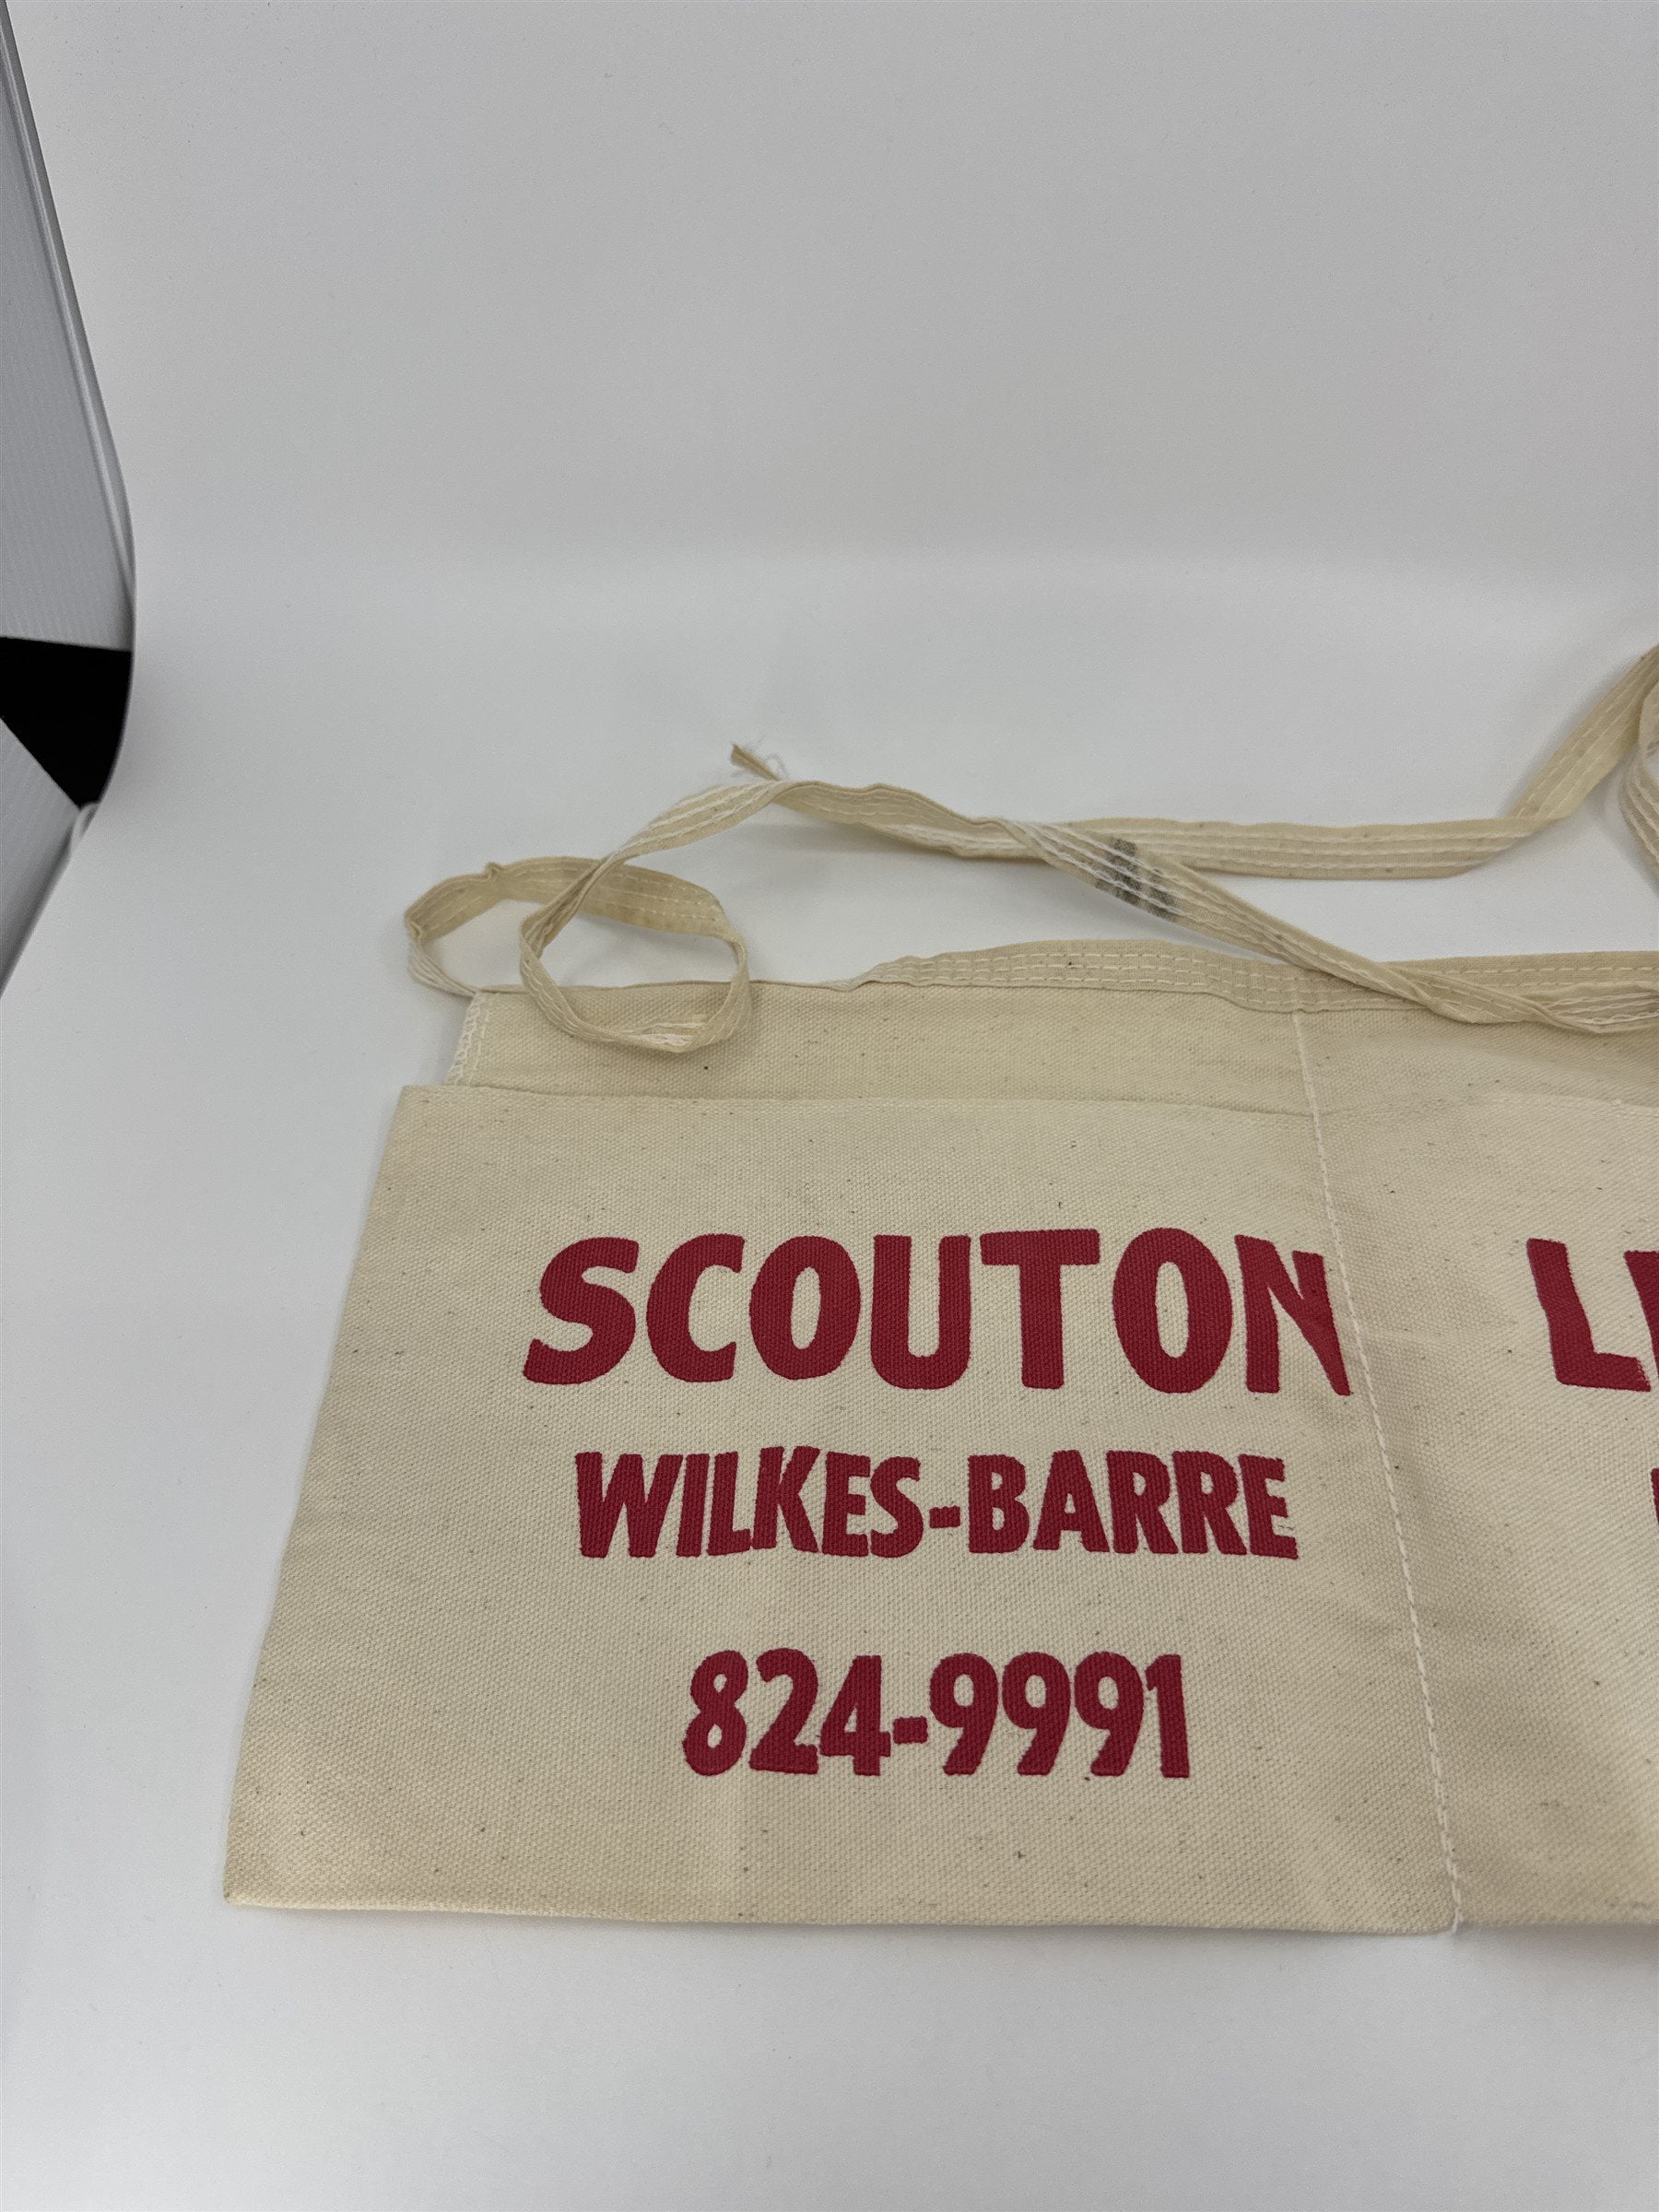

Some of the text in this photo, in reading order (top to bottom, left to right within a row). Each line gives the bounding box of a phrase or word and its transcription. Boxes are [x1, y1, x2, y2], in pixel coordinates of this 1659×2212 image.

[524, 1228, 1350, 1396] SCOUTON
[575, 1446, 1299, 1560] WILKES-BARRE
[682, 1648, 1190, 1778] 824-9991
